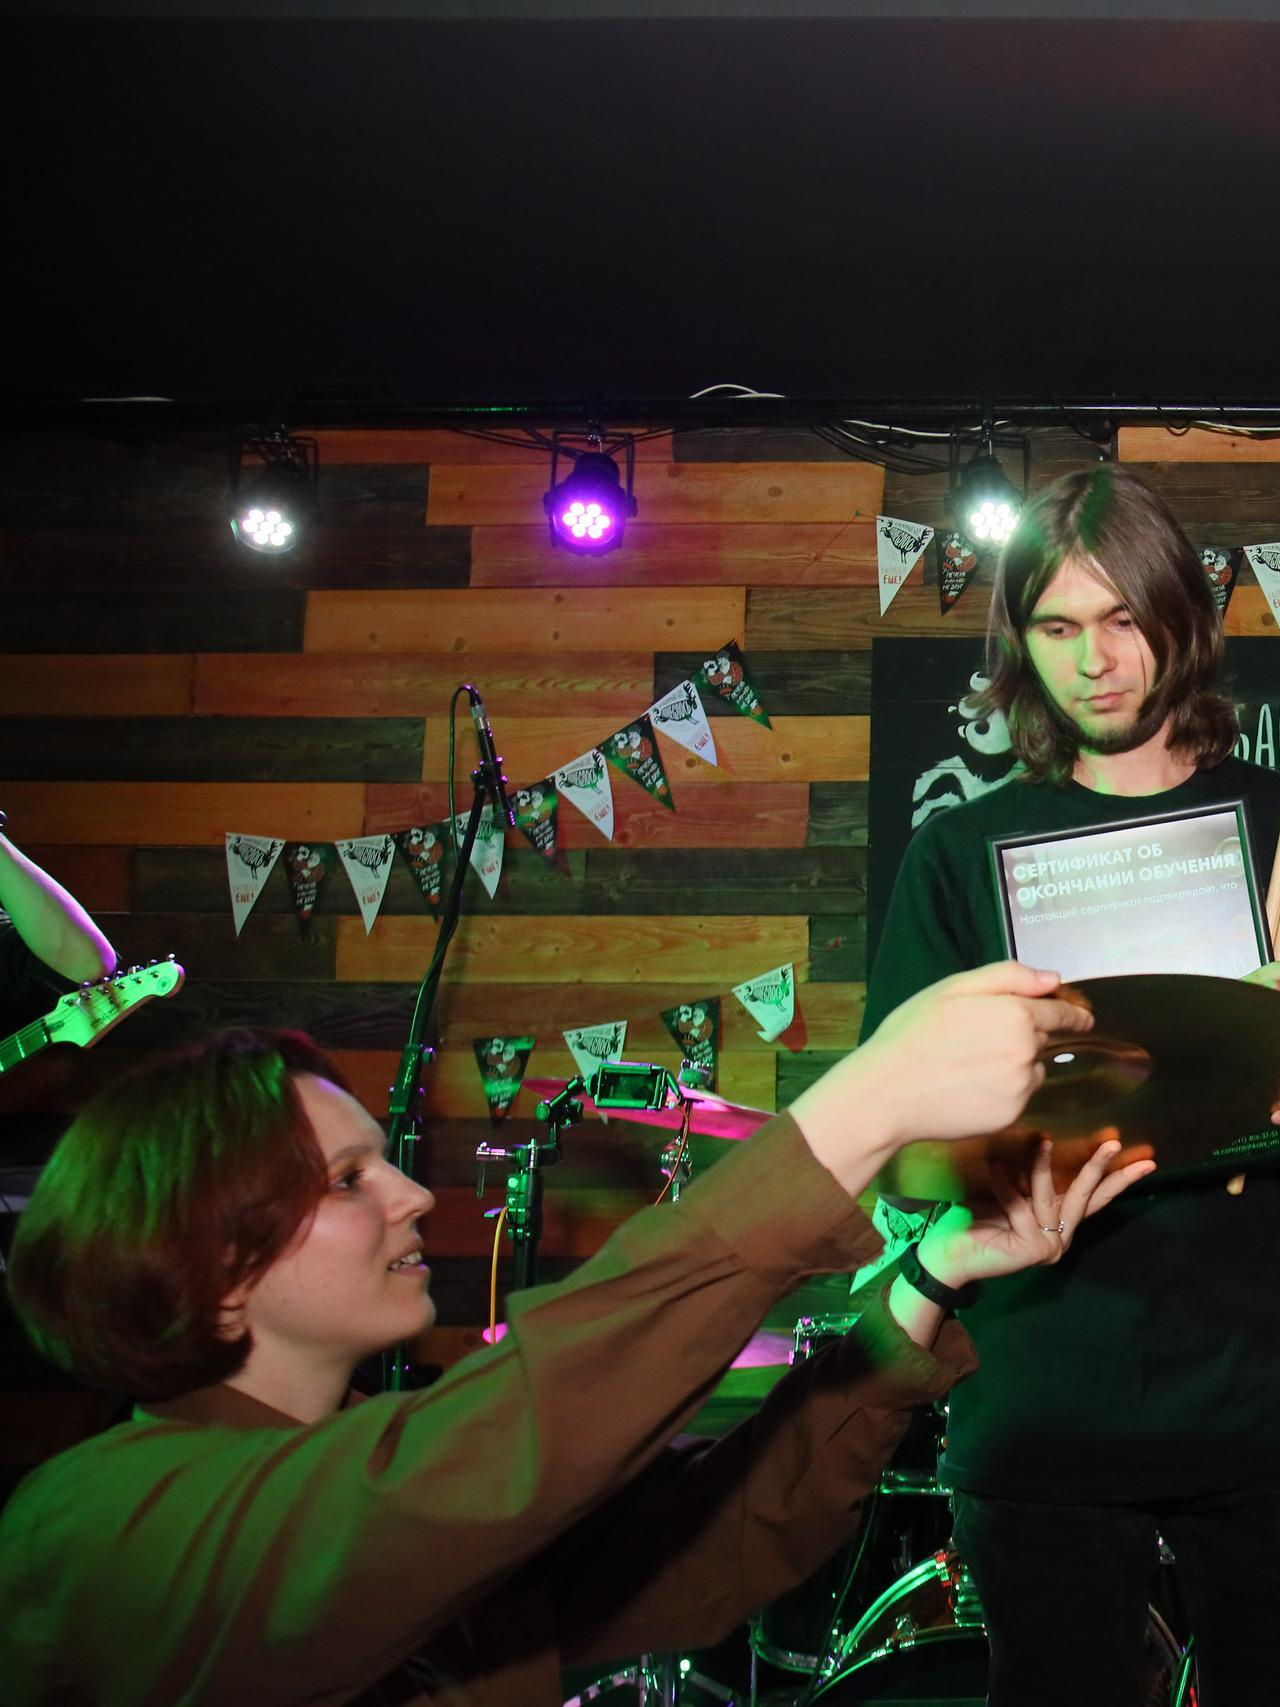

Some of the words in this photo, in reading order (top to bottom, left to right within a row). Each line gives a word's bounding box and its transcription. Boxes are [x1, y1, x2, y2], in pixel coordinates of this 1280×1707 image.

[1012, 846, 1133, 881] СЕРТИФИКАТ
[1137, 843, 1163, 860] ОБ
[1016, 870, 1135, 903] ОКОНЧАНИИ
[1139, 852, 1236, 882] ОБУЧЕНИЯ
[1019, 907, 1079, 925] Настоящий
[1080, 897, 1142, 915] сертификат
[1221, 881, 1238, 892] что
